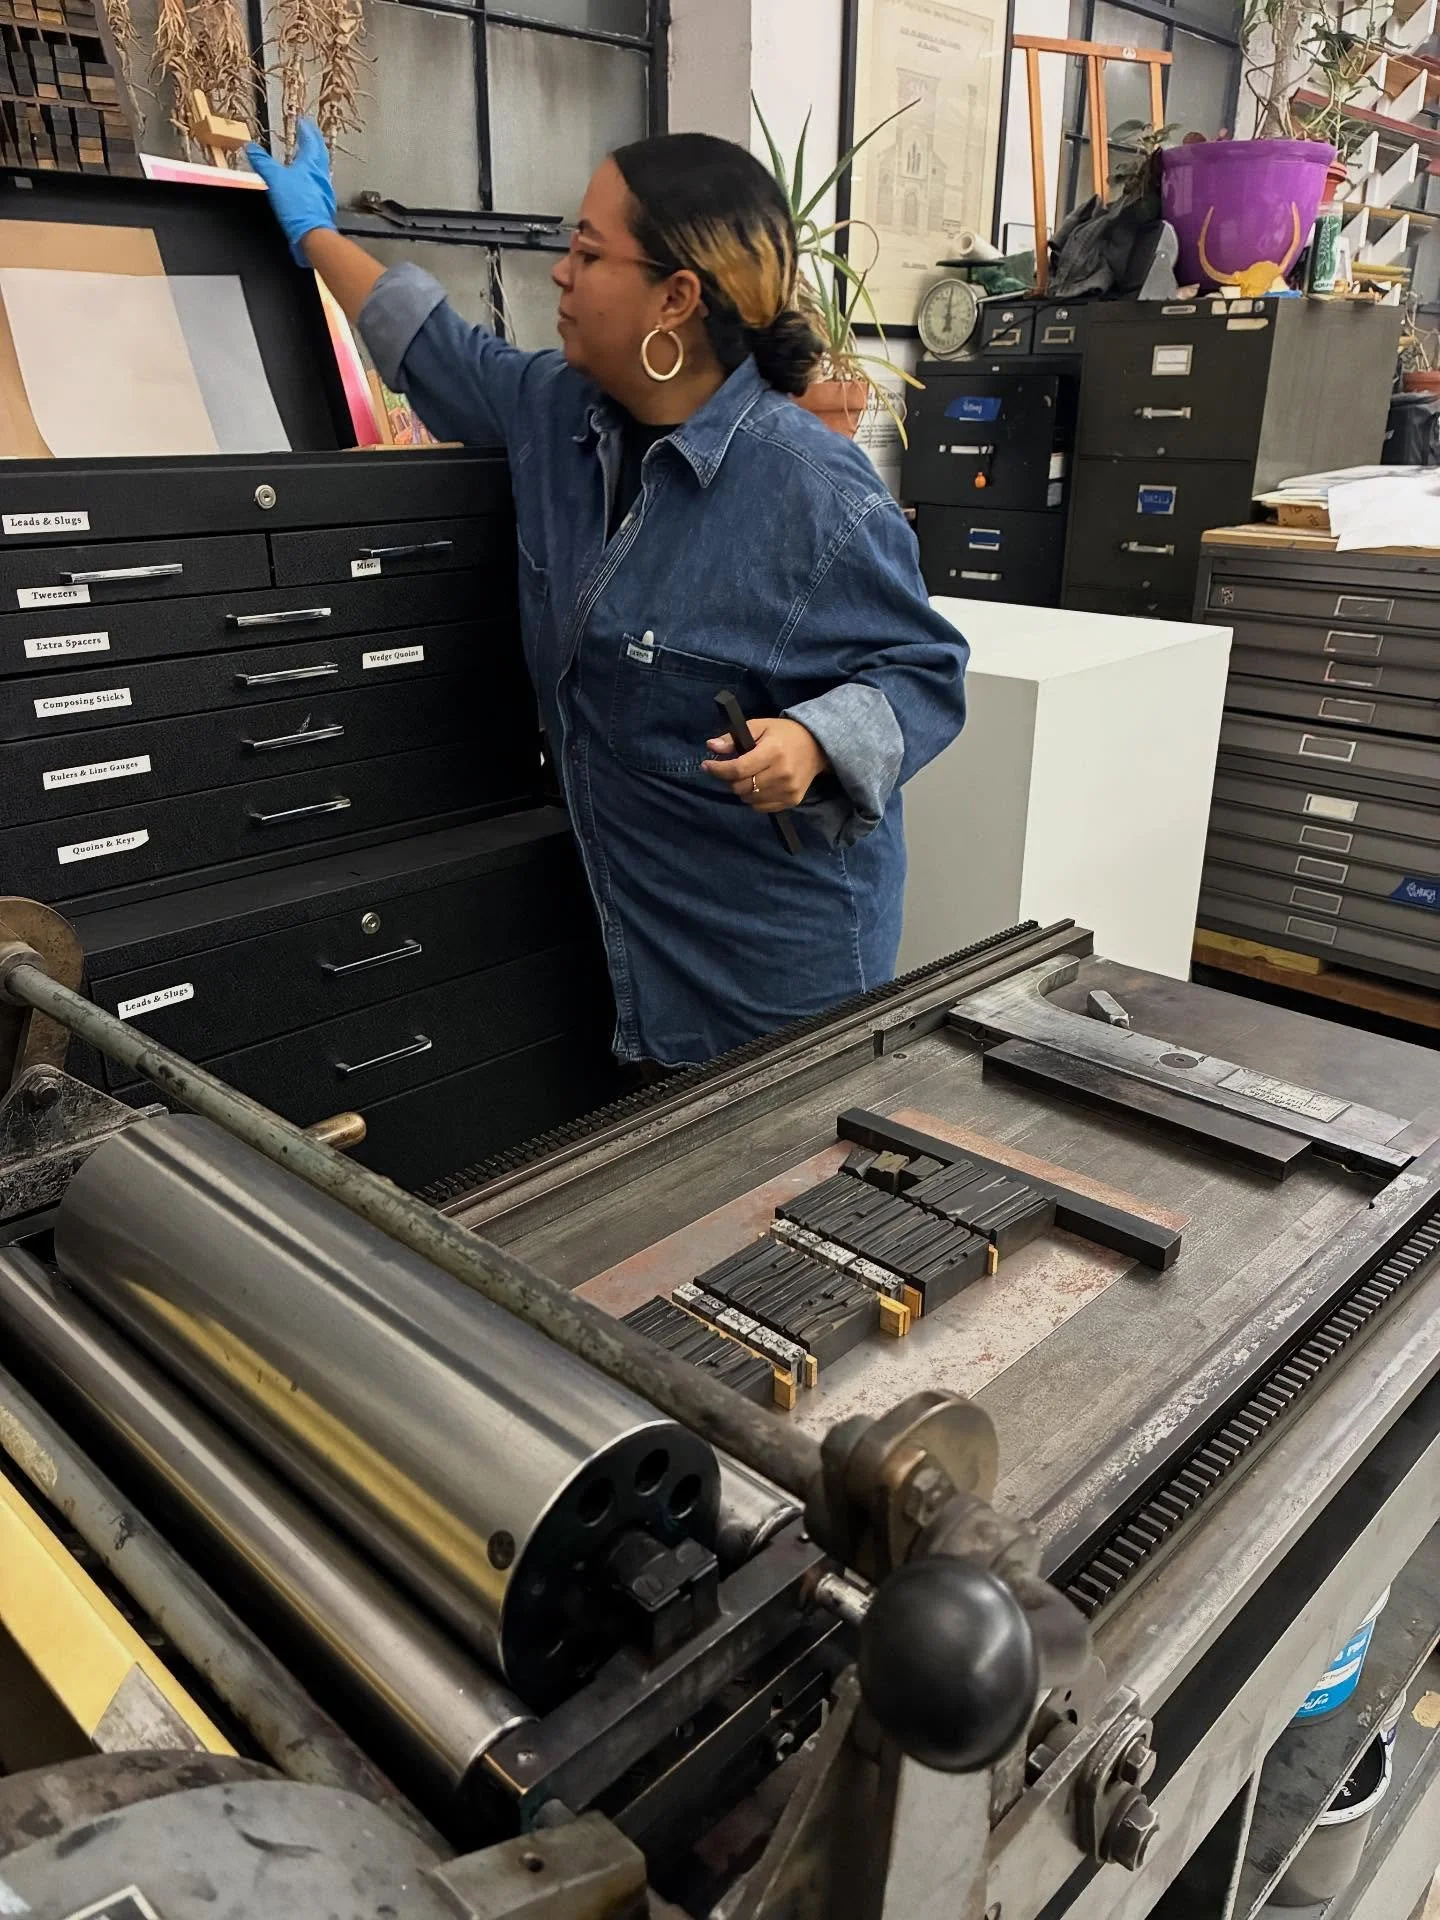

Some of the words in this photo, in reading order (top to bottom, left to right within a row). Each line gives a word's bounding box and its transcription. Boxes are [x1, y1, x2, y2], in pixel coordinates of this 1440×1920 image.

[10, 517, 40, 527] Leads
[43, 517, 51, 526] &
[54, 516, 82, 526] Slugs
[356, 562, 376, 570] Misc.
[32, 590, 78, 600] Tweezers
[36, 641, 63, 650] Extra
[65, 637, 102, 648] Spacers
[369, 653, 392, 662] Wedge
[394, 650, 419, 659] Quoins
[43, 697, 95, 709] Composing
[96, 692, 125, 703] Sticks
[50, 772, 78, 782] Rulers
[89, 767, 108, 775] Line
[109, 761, 139, 771] Gauges
[72, 843, 104, 855] Quoins
[116, 836, 136, 846] Keys
[125, 998, 151, 1011] Leads
[153, 995, 161, 1003] &
[163, 988, 188, 999] Slugs
